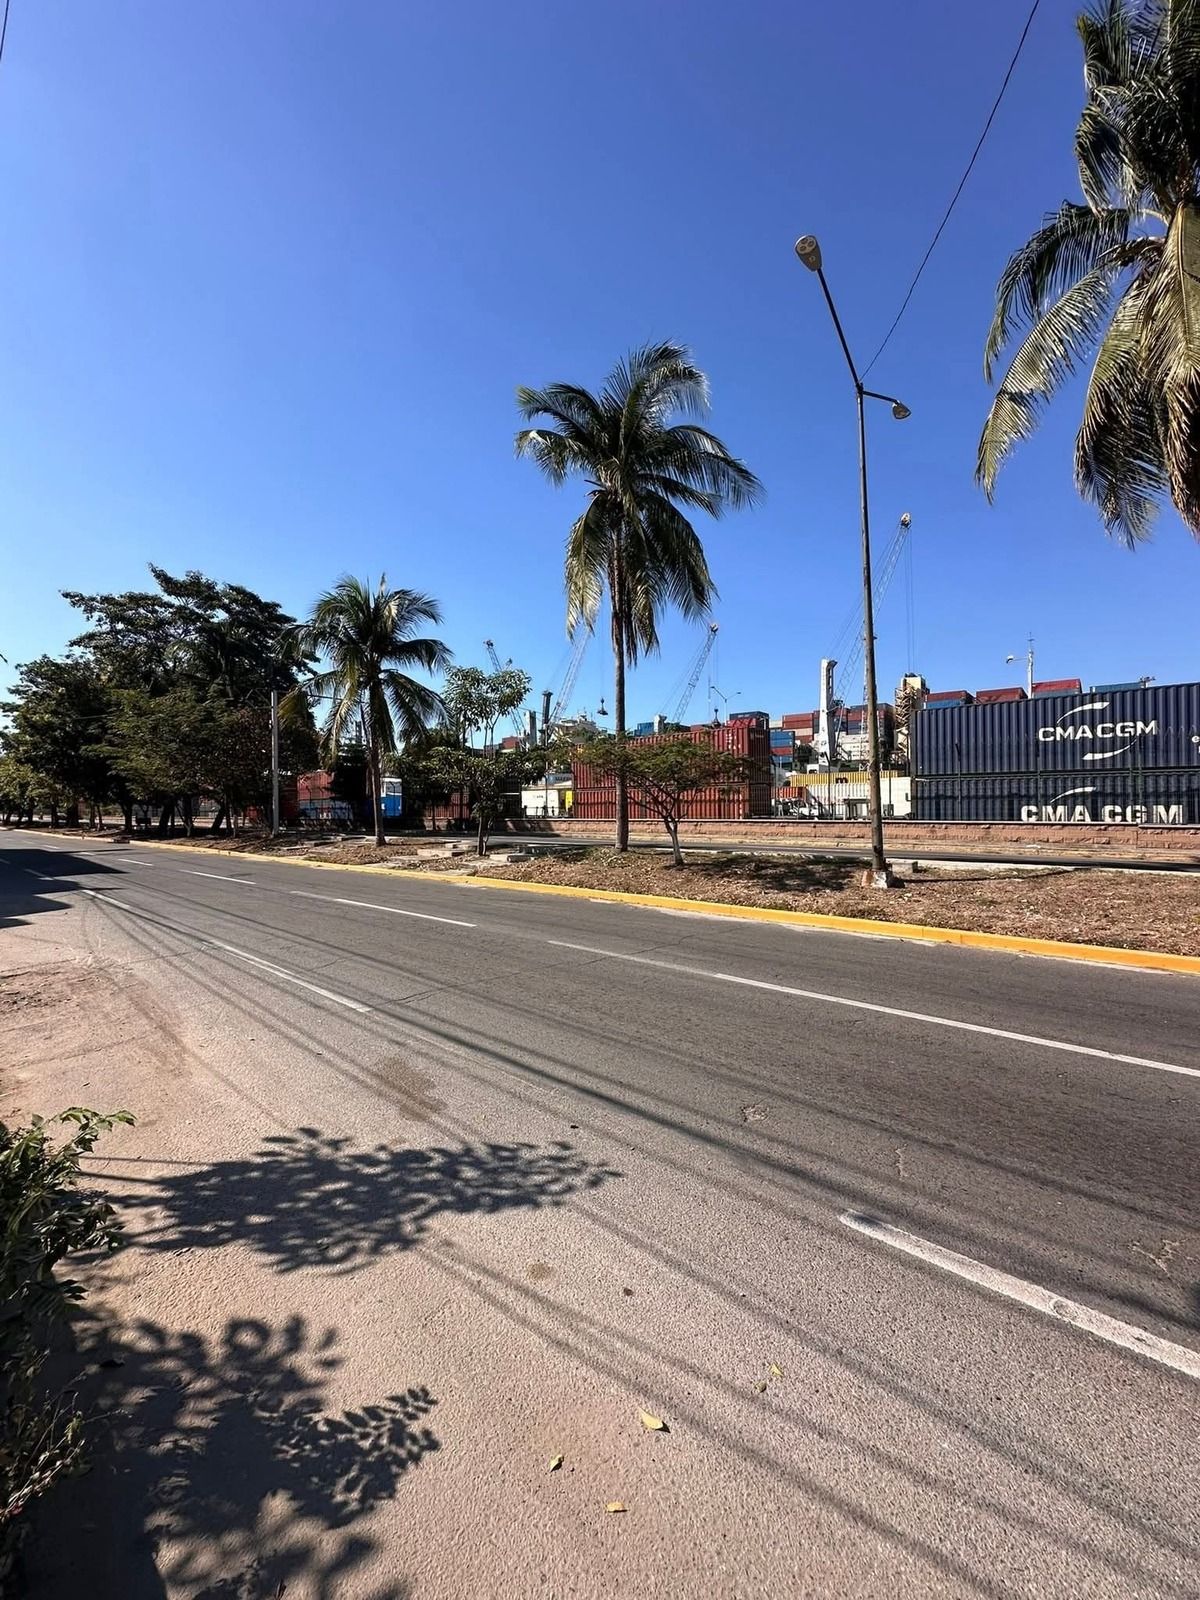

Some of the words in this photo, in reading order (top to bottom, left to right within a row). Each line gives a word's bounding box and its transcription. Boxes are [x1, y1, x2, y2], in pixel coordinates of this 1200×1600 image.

[1038, 725, 1093, 741] CMA
[1097, 720, 1157, 738] CGM
[1020, 805, 1091, 823] CMA
[1103, 805, 1183, 824] CGM
